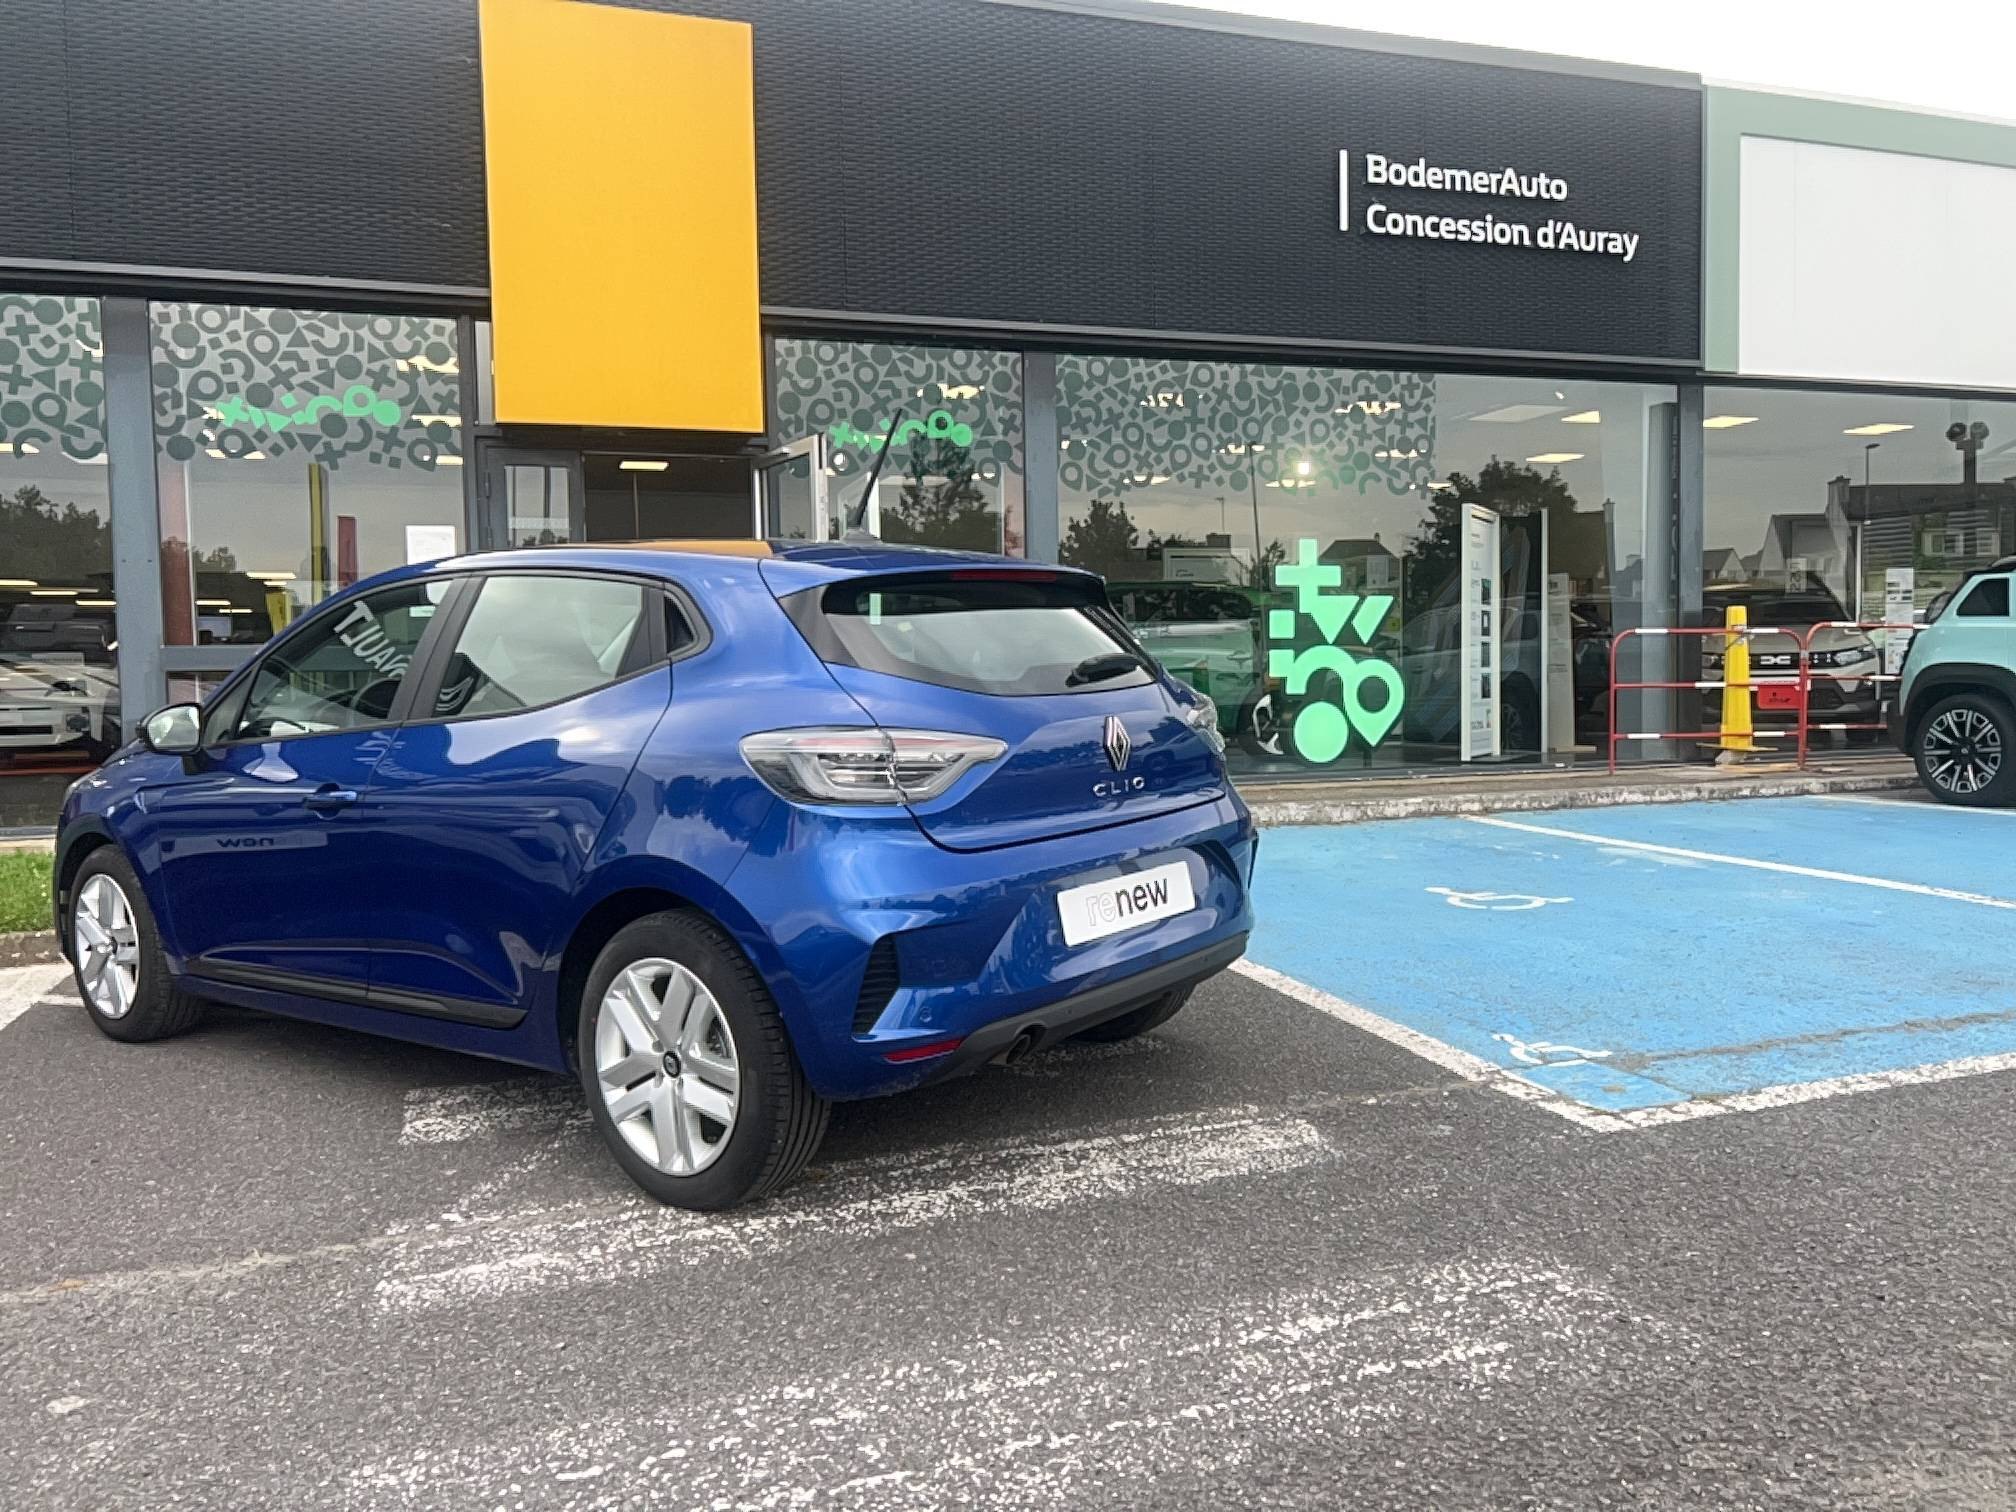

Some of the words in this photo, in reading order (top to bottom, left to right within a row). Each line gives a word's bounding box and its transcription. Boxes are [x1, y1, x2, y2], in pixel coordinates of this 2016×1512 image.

[1366, 153, 1568, 200] BodemerAuto
[1366, 204, 1530, 246] Concession
[1536, 219, 1639, 262] d'Auray
[1092, 776, 1145, 797] CLIO
[1086, 878, 1168, 926] renew
